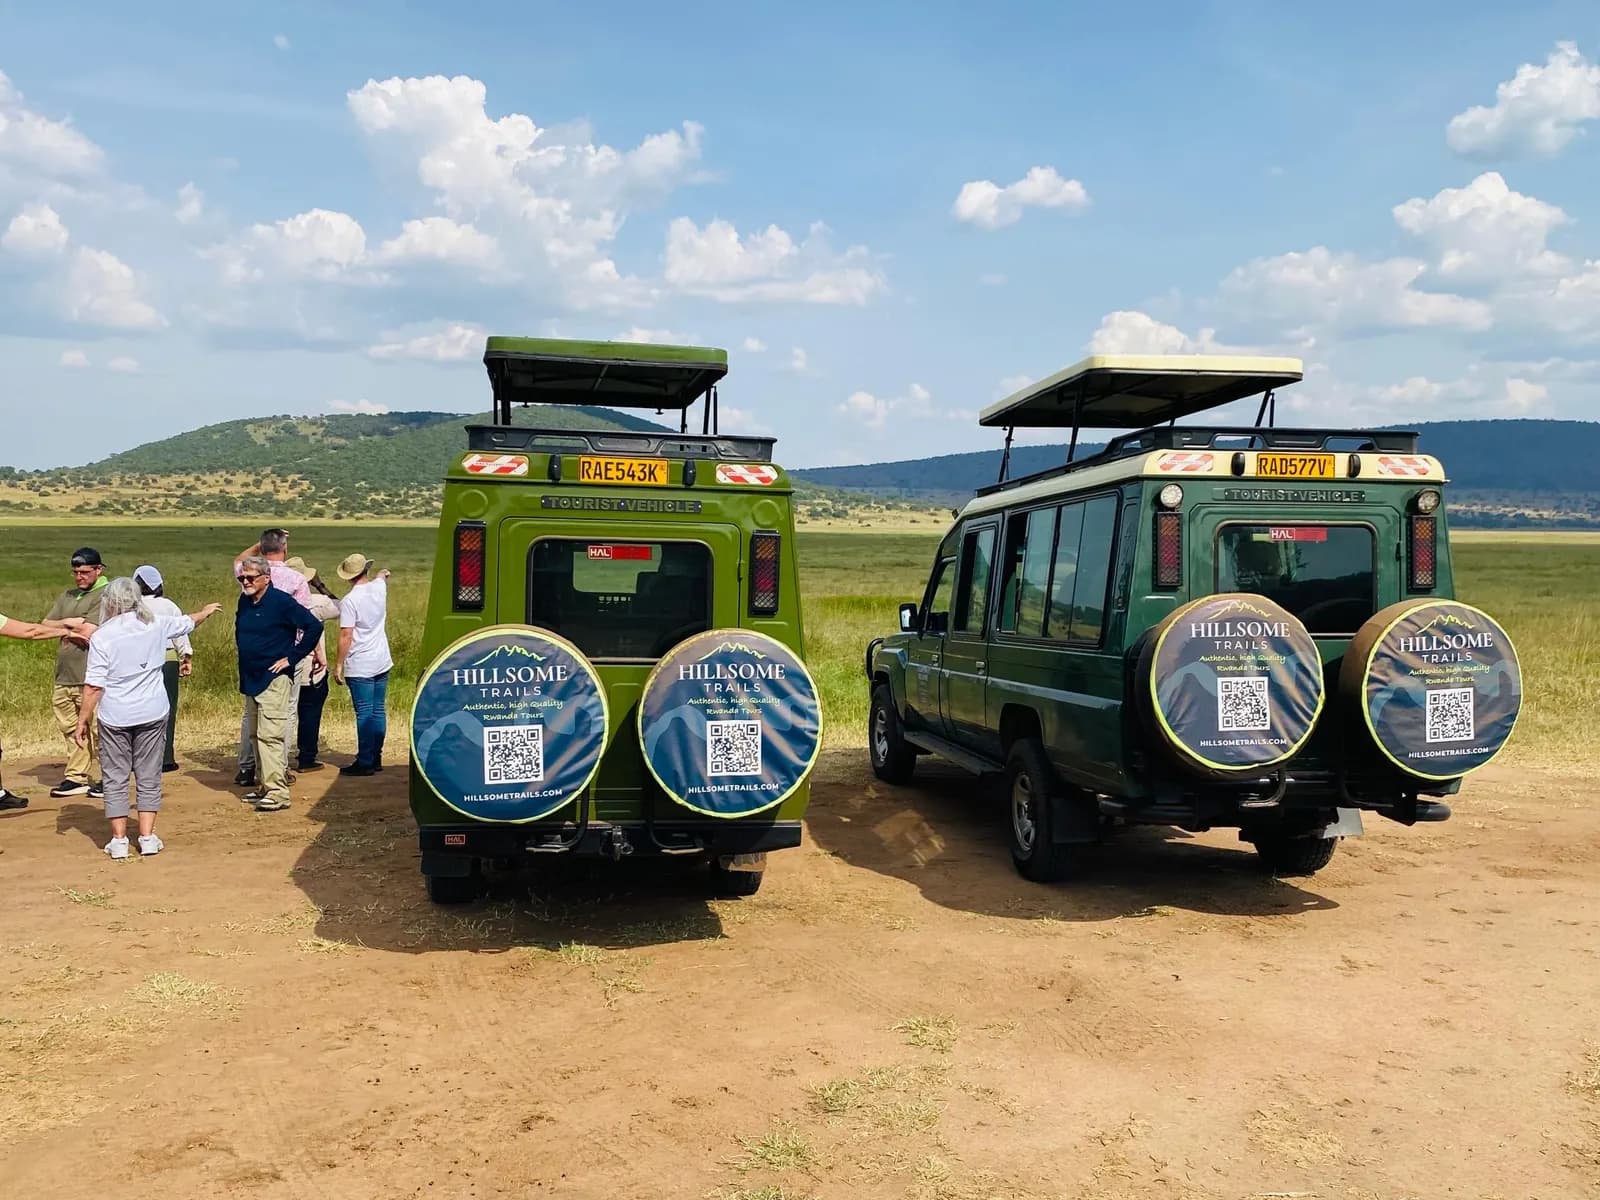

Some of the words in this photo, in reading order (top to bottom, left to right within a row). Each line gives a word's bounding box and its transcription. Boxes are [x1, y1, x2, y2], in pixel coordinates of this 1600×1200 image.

[581, 460, 659, 482] RAE543K
[1259, 457, 1326, 475] RAD577V
[1231, 489, 1294, 500] TOURIST
[1298, 490, 1359, 501] VEHICLE
[548, 496, 621, 510] TOURIST
[625, 499, 694, 512] VEHICLE
[1270, 529, 1293, 539] HAL
[590, 548, 610, 557] HAL
[1190, 621, 1291, 638] HILLSOME
[1214, 640, 1269, 650] TRAILS
[1400, 632, 1493, 653] HILLSOME
[1239, 653, 1256, 663] high
[1422, 652, 1473, 664] TRAILS
[452, 664, 568, 687] HILLSOME
[678, 663, 785, 681] HILLSOME
[480, 686, 542, 698] TRAILS
[704, 682, 761, 693] TRAILS
[462, 701, 507, 711] Authentic,
[509, 701, 528, 710] high
[529, 699, 564, 709] Quality
[687, 696, 729, 705] Authentic,
[730, 696, 748, 706] high
[749, 696, 781, 706] Quality
[483, 712, 518, 721] Rwanda
[1200, 738, 1287, 747] HILLSOMETRAILS.COM
[1408, 746, 1489, 758] HILLSOMETRAILS.COM
[688, 783, 779, 794] HILLSOMETRAILS.COM
[464, 788, 563, 802] HILLSOMETRAILS.COM
